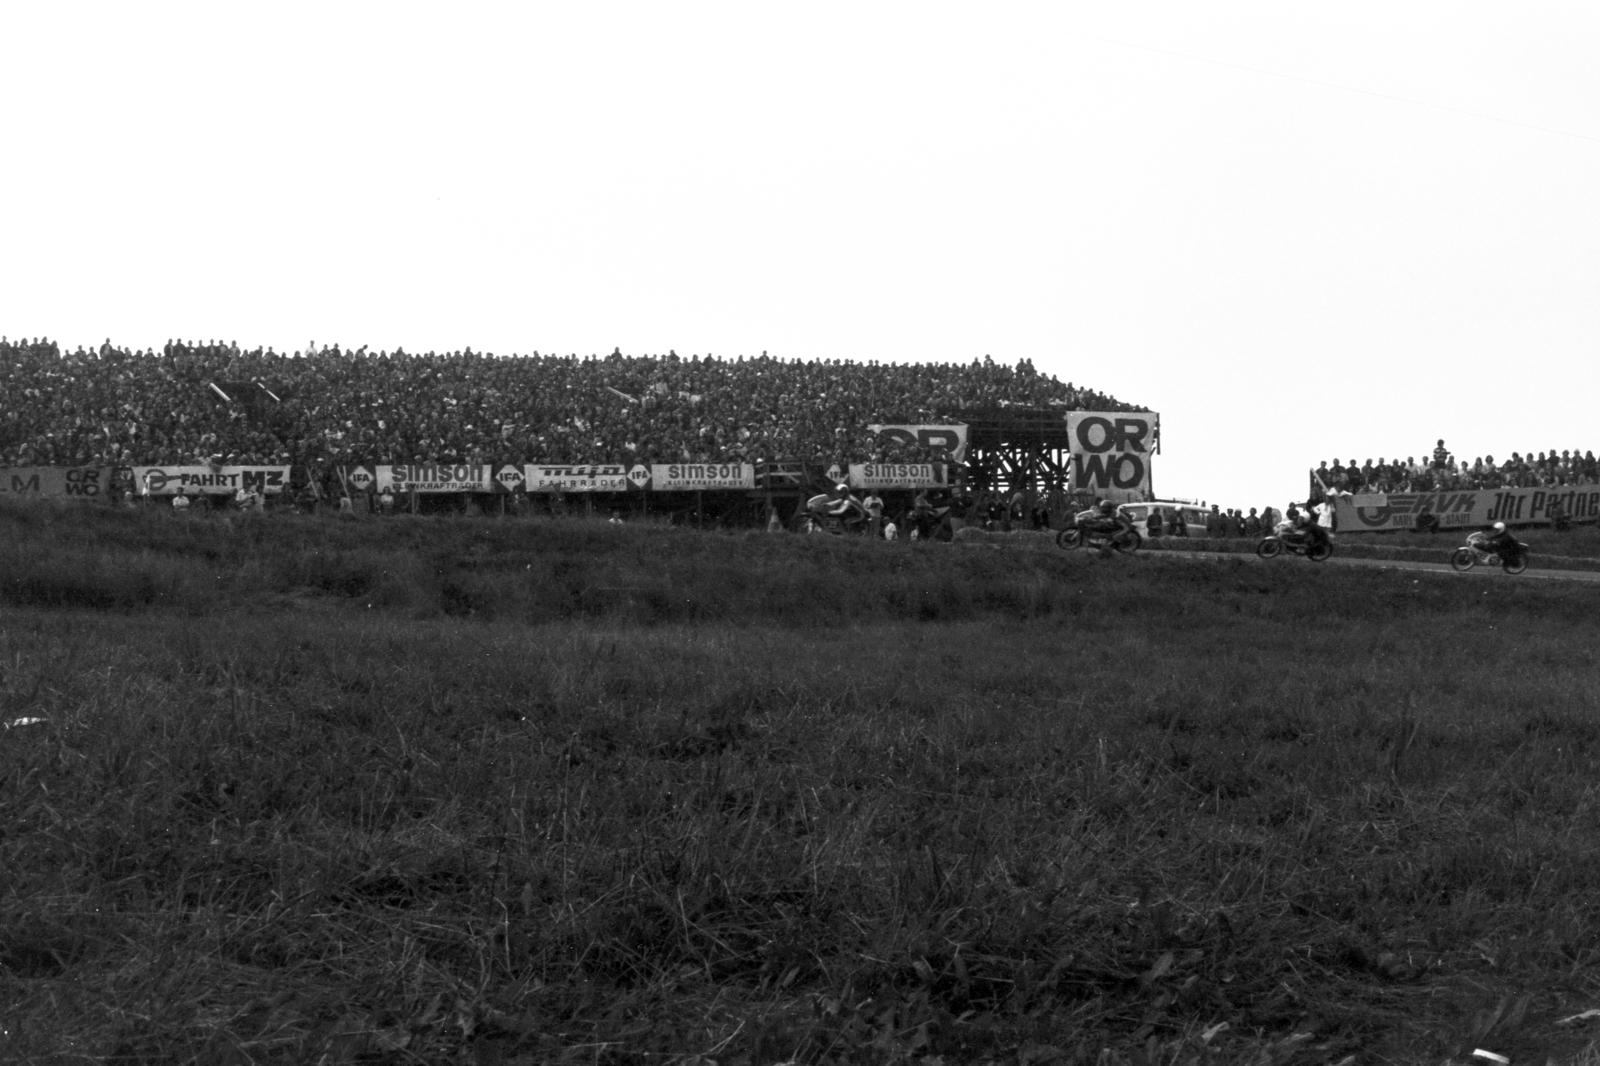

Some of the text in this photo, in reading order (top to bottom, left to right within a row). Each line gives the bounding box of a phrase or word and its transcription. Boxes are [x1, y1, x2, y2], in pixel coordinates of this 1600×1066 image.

[1076, 416, 1148, 453] OR
[181, 469, 284, 487] FAHRT MZ
[352, 473, 370, 482] IFA
[391, 465, 483, 482] simson
[499, 473, 521, 482] IFA
[632, 471, 647, 480] IFA
[668, 465, 741, 479] simson
[864, 464, 929, 478] simson
[1075, 453, 1144, 489] WO
[66, 483, 99, 497] WO
